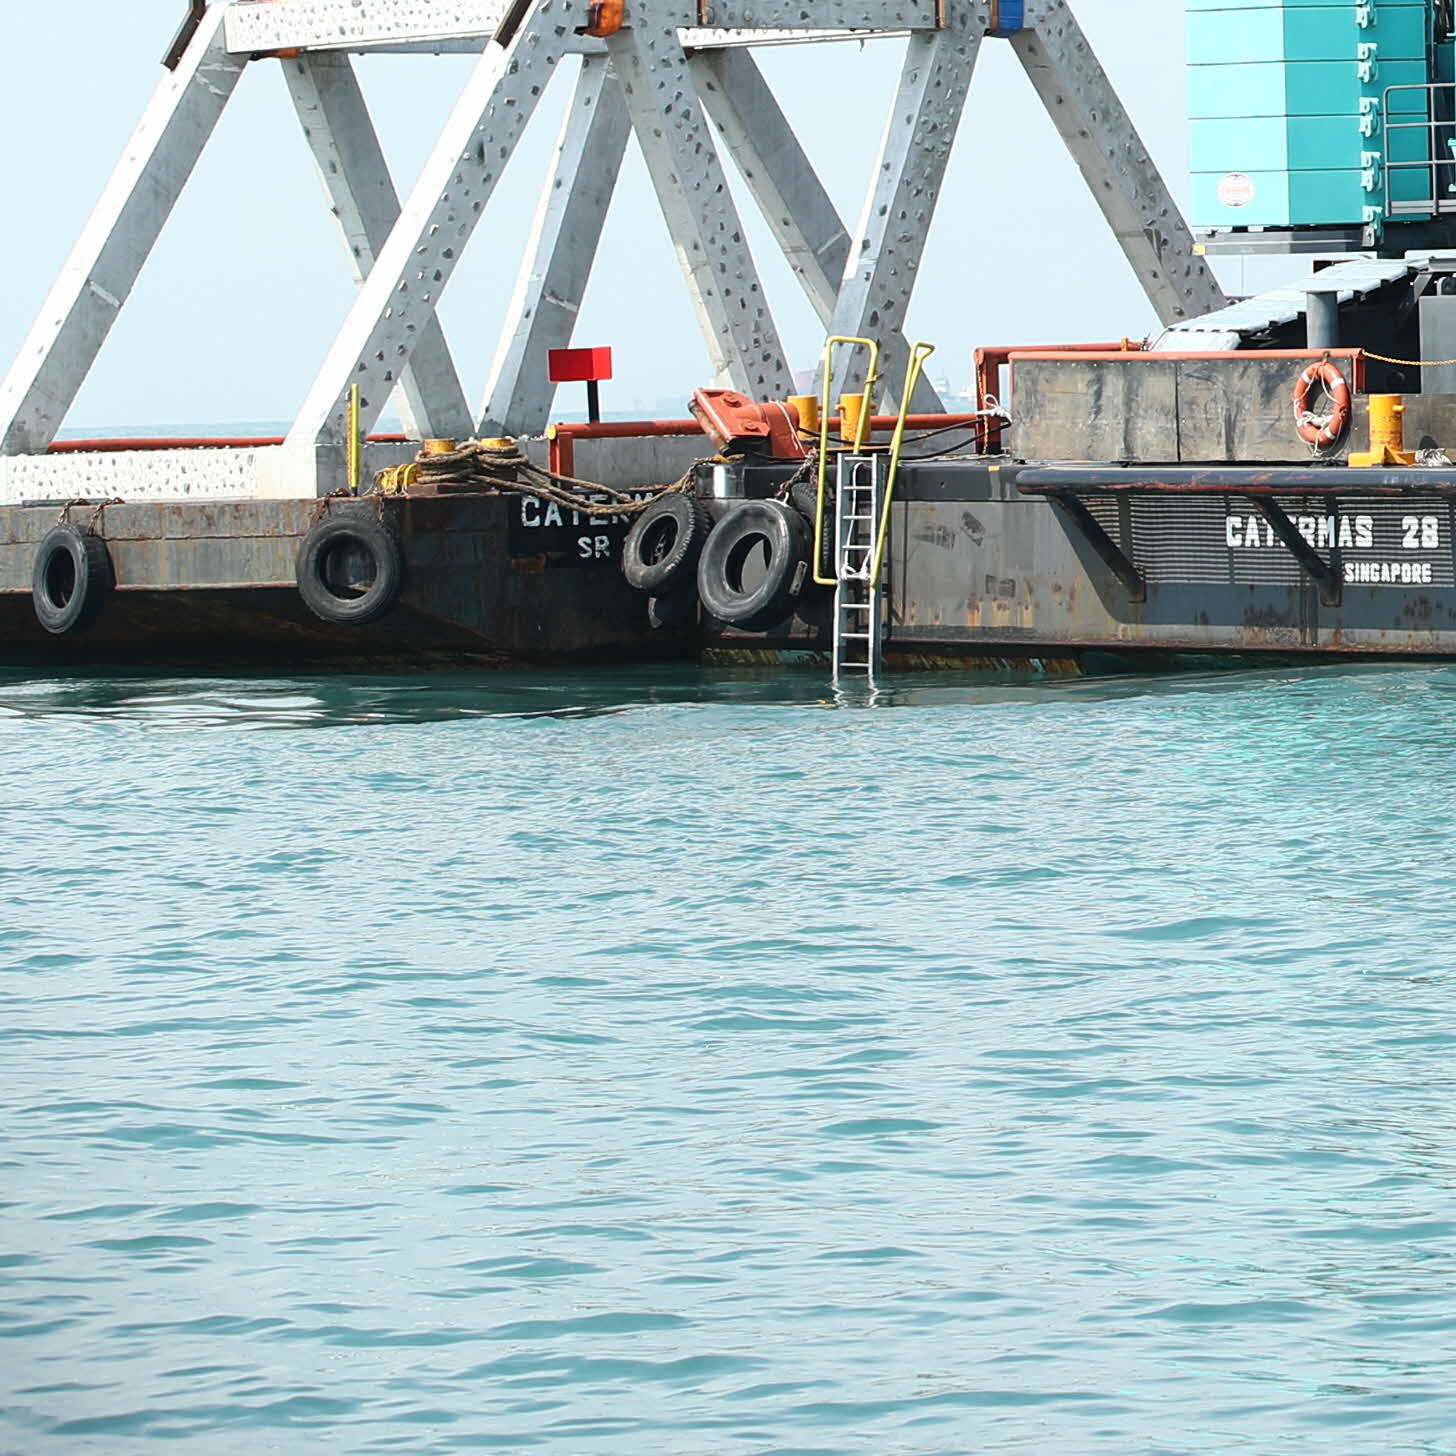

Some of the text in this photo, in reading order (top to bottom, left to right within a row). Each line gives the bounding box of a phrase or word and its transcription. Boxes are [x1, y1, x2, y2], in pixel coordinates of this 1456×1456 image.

[1225, 515, 1440, 548] CATRMAS 28
[577, 536, 611, 559] SR
[1344, 562, 1433, 584] SINGAPORE
